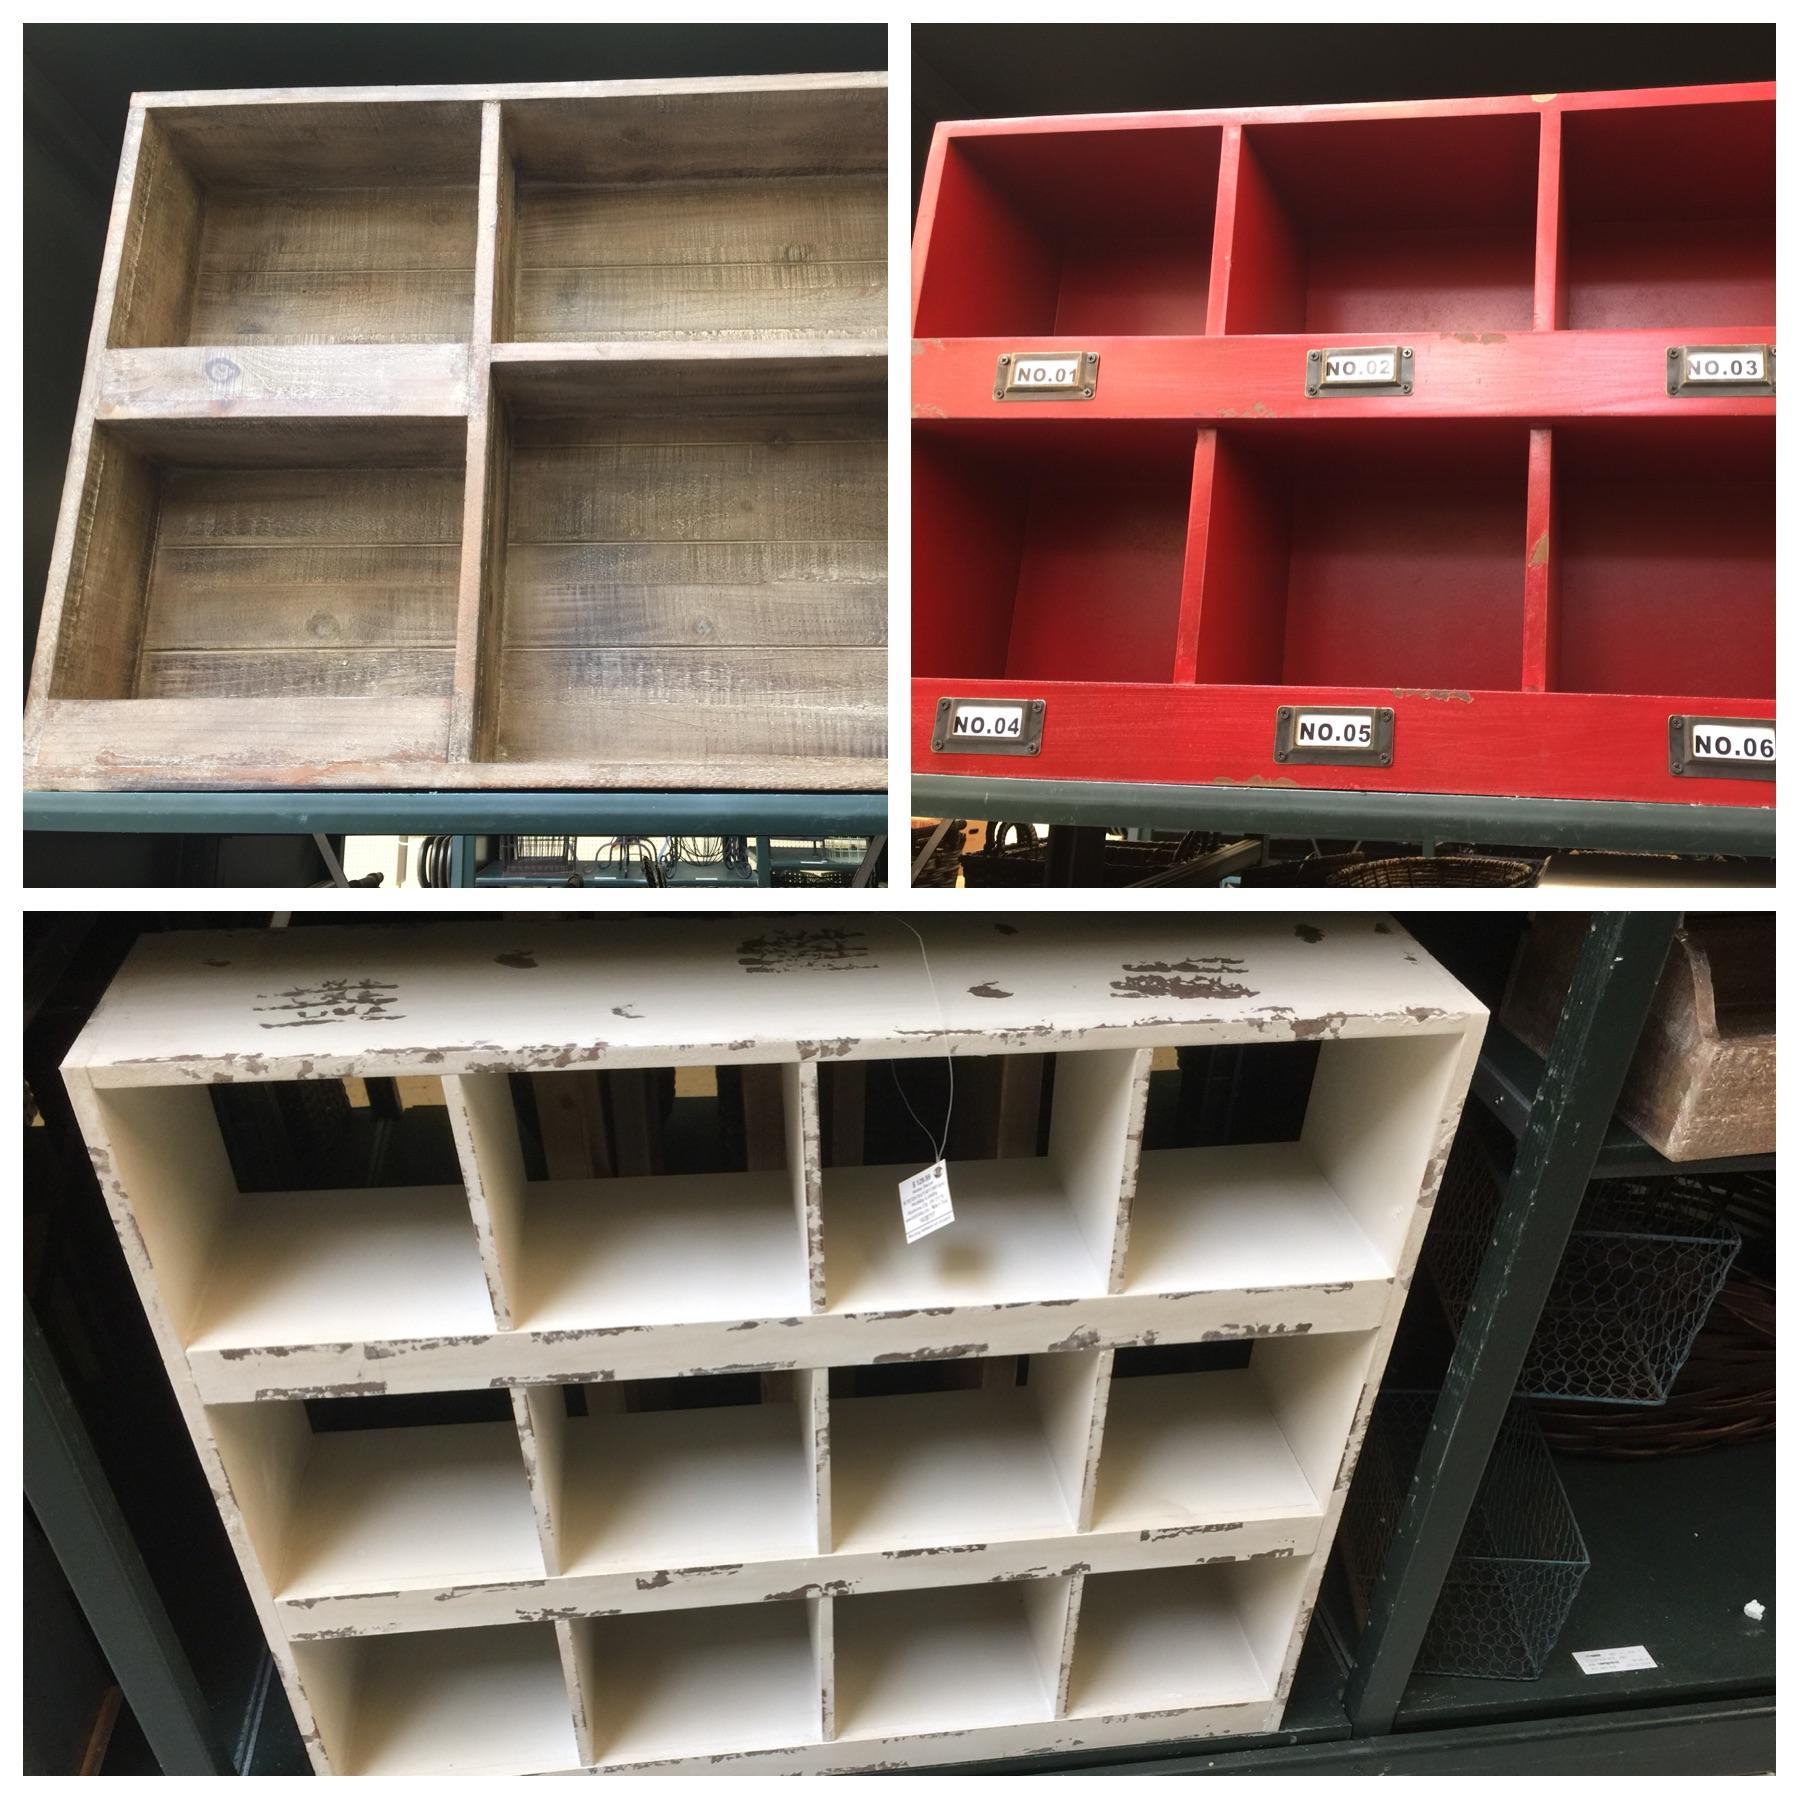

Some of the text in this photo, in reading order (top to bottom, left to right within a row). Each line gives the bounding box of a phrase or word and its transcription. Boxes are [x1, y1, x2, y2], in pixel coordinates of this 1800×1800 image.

[1017, 367, 1076, 383] NO.01
[1325, 359, 1391, 377] NO.02
[1687, 359, 1758, 376] NO.03
[953, 715, 1020, 735] NO.04
[1299, 722, 1371, 743] NO.05
[1694, 734, 1775, 758] NO.06
